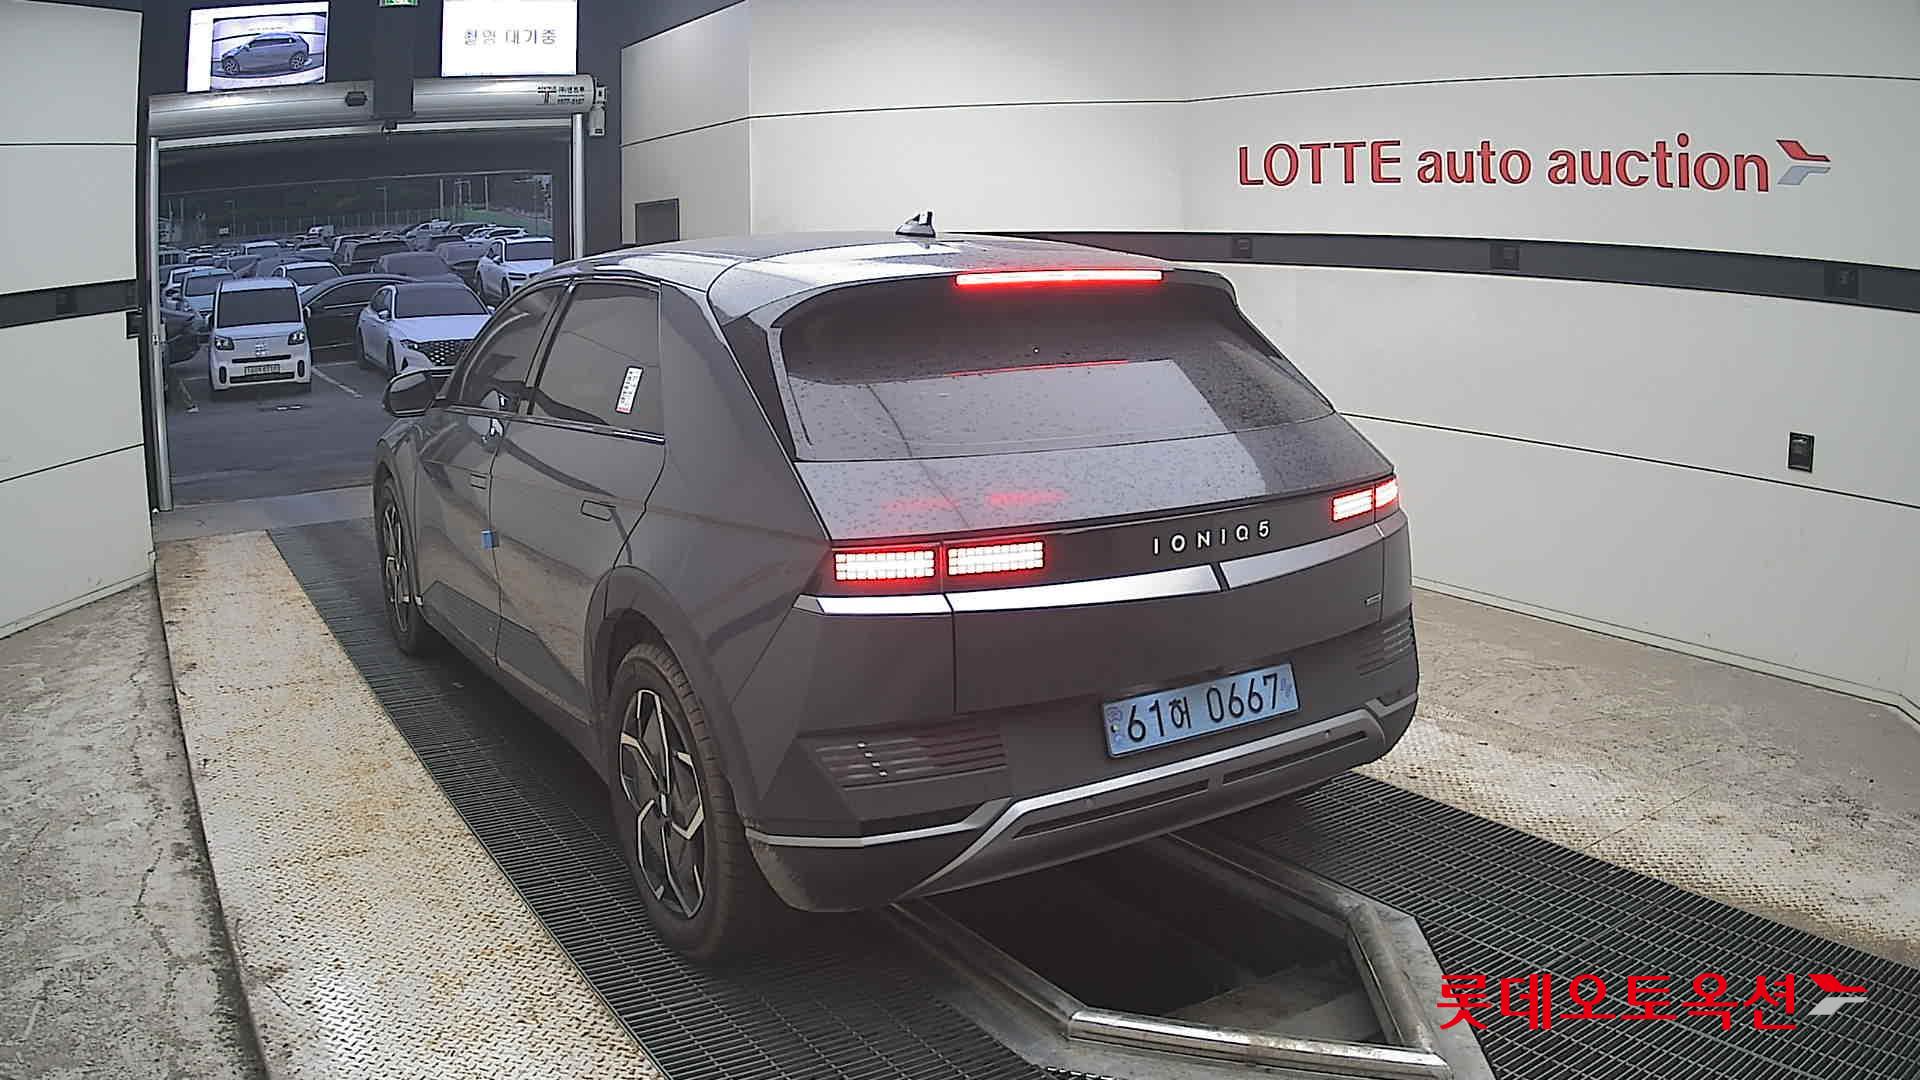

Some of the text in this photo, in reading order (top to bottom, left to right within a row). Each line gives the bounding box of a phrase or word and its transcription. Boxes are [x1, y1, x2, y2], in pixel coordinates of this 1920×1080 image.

[505, 28, 558, 45] 대기중
[1239, 132, 1770, 193] LOTTE auto auction
[1127, 672, 1279, 743] 61허 0667
